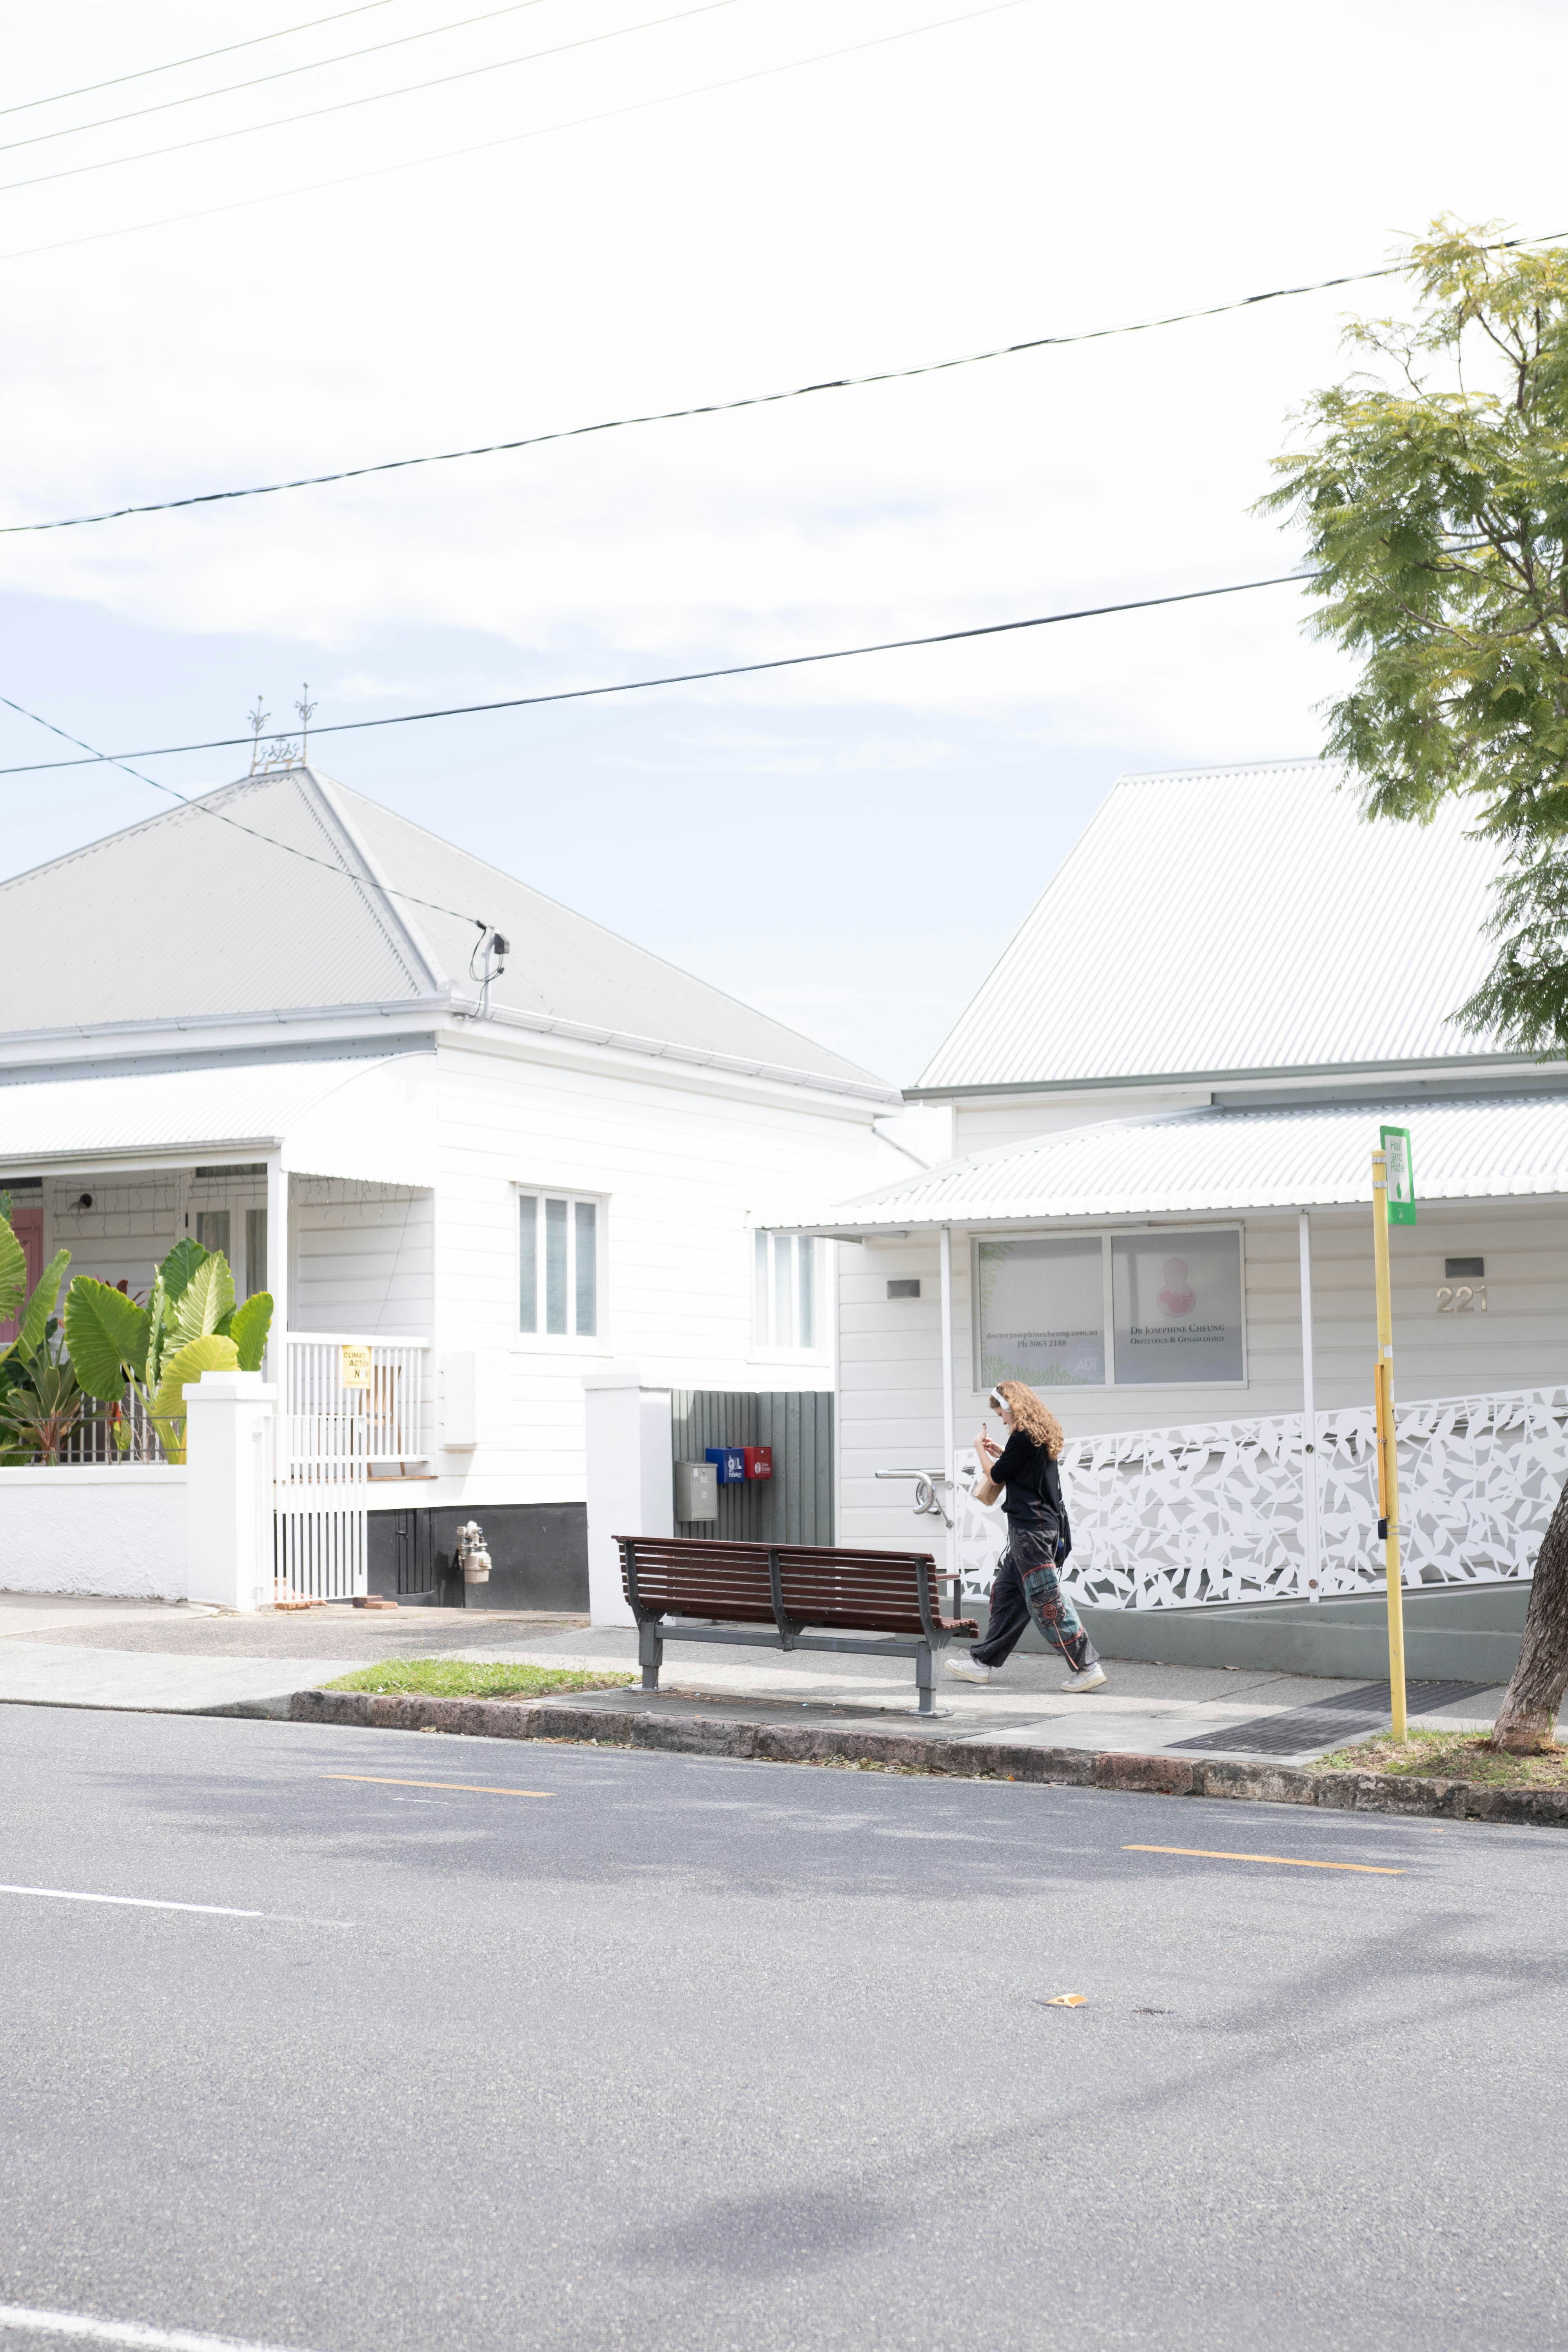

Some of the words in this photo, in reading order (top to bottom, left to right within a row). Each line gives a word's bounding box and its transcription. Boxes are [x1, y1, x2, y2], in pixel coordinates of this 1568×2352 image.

[1390, 1140, 1402, 1151] Hail
[1392, 1152, 1402, 1161] and
[1391, 1161, 1404, 1172] Ride
[1436, 1285, 1486, 1313] 221
[986, 1330, 1098, 1340] doctorjosephinecheung.com.au
[1075, 1357, 1100, 1370] ADT
